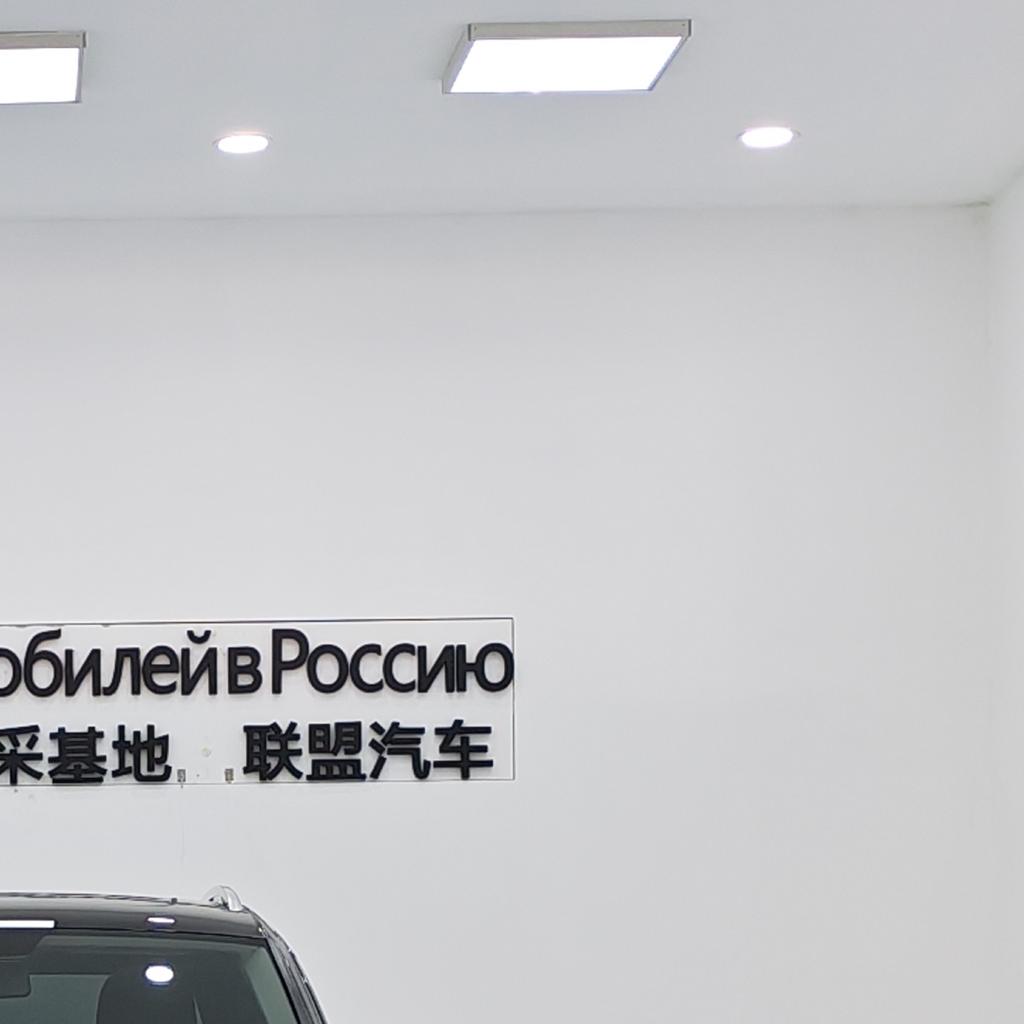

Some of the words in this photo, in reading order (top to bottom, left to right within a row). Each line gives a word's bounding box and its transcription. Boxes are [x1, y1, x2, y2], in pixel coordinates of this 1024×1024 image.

[228, 647, 262, 694] в
[272, 629, 512, 694] Россию
[243, 720, 493, 780] 联盟汽车
